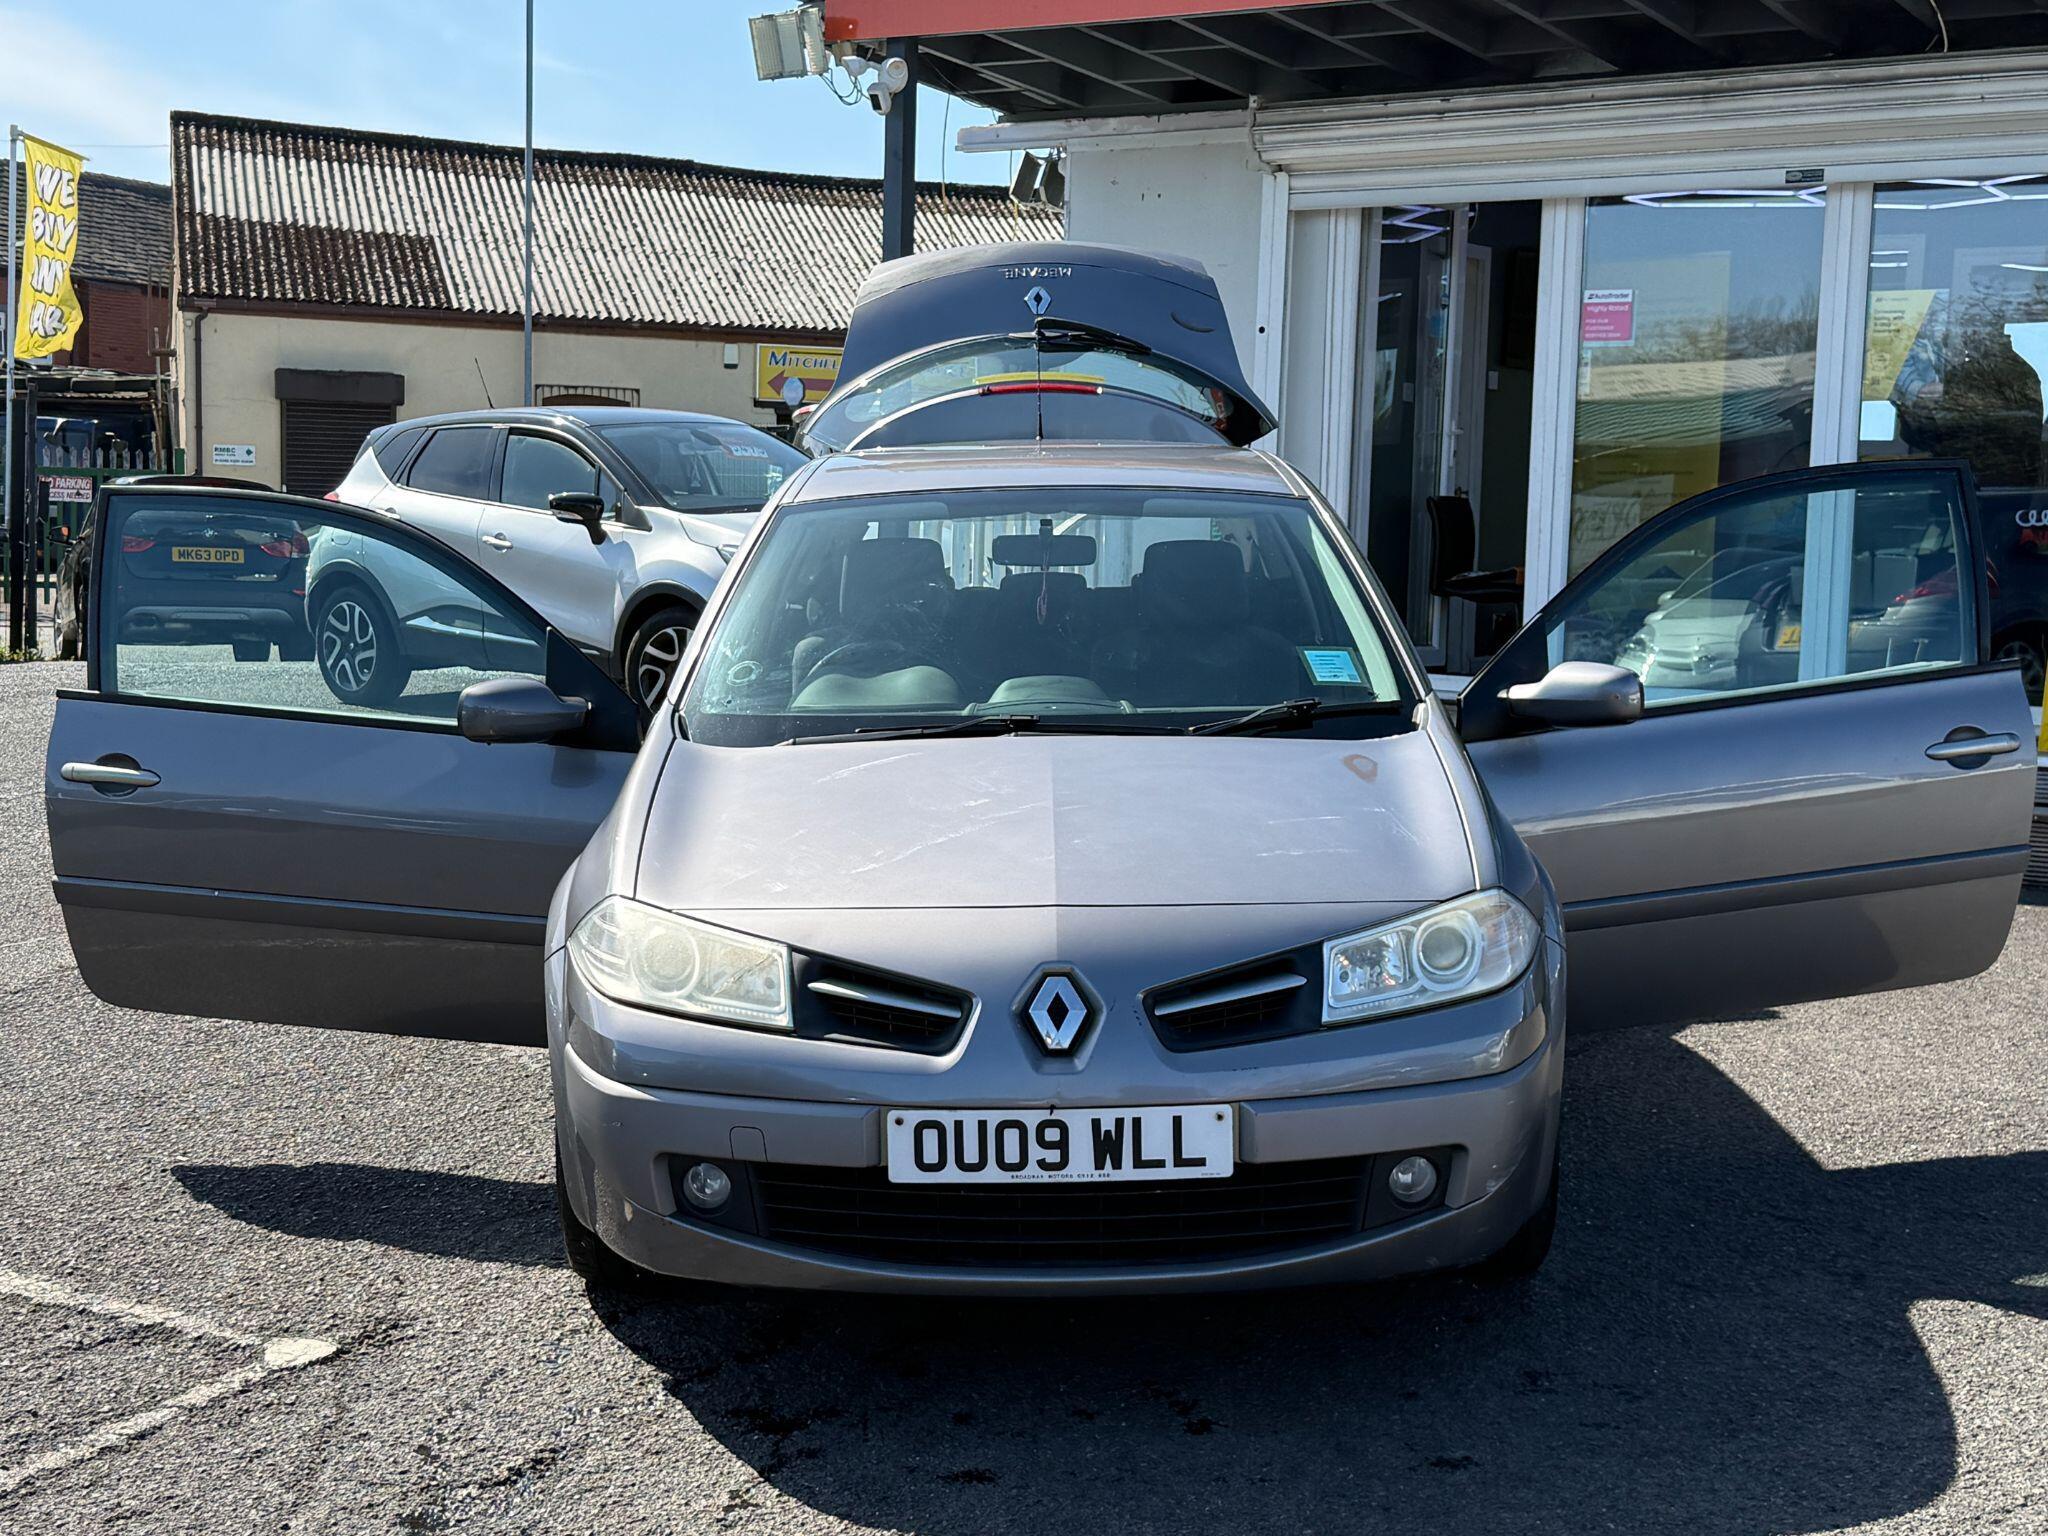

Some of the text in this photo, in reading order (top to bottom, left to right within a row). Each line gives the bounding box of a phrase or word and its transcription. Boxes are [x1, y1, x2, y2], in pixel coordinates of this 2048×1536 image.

[34, 161, 75, 207] WE
[32, 205, 77, 253] BUY
[1005, 267, 1072, 279] MEGANE
[56, 478, 91, 490] PARKING
[177, 548, 212, 561] MK63
[913, 1115, 1207, 1173] OU09 WLL
